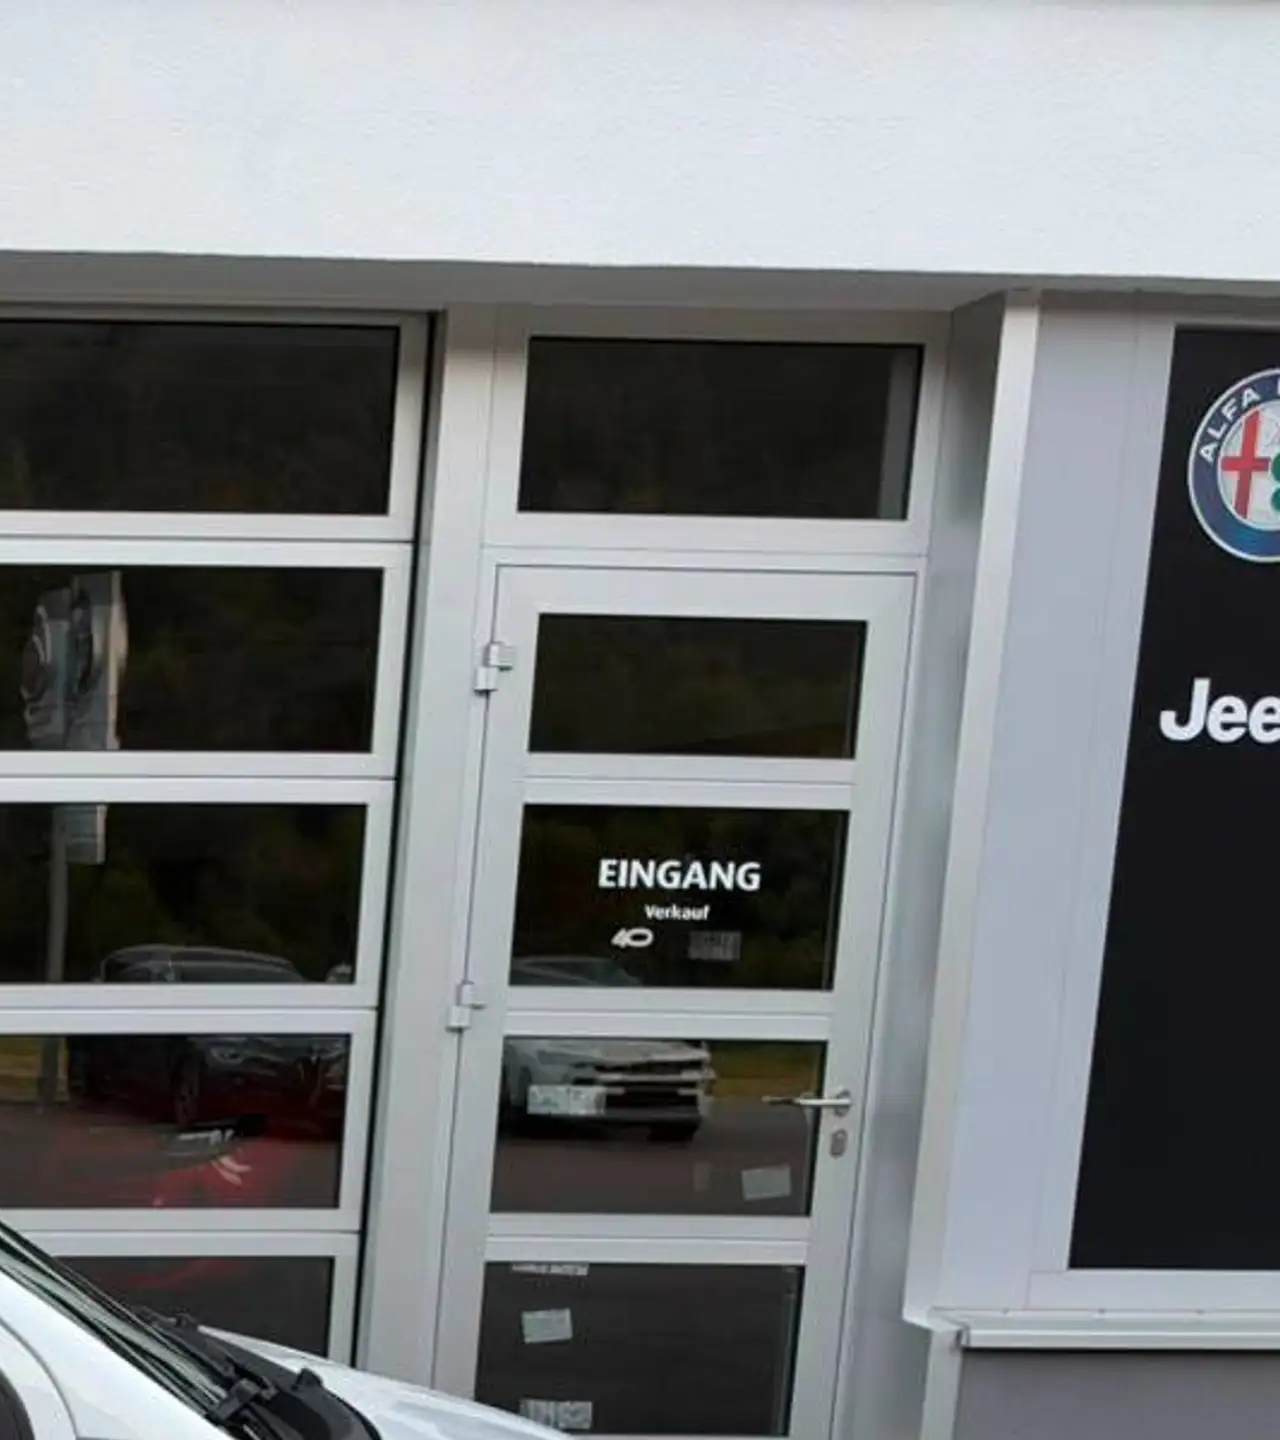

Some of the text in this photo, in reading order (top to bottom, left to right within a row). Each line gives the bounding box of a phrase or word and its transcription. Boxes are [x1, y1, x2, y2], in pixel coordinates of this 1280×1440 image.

[1200, 387, 1262, 464] ALFA
[598, 858, 762, 892] EINGANG
[644, 903, 711, 921] Verkauf
